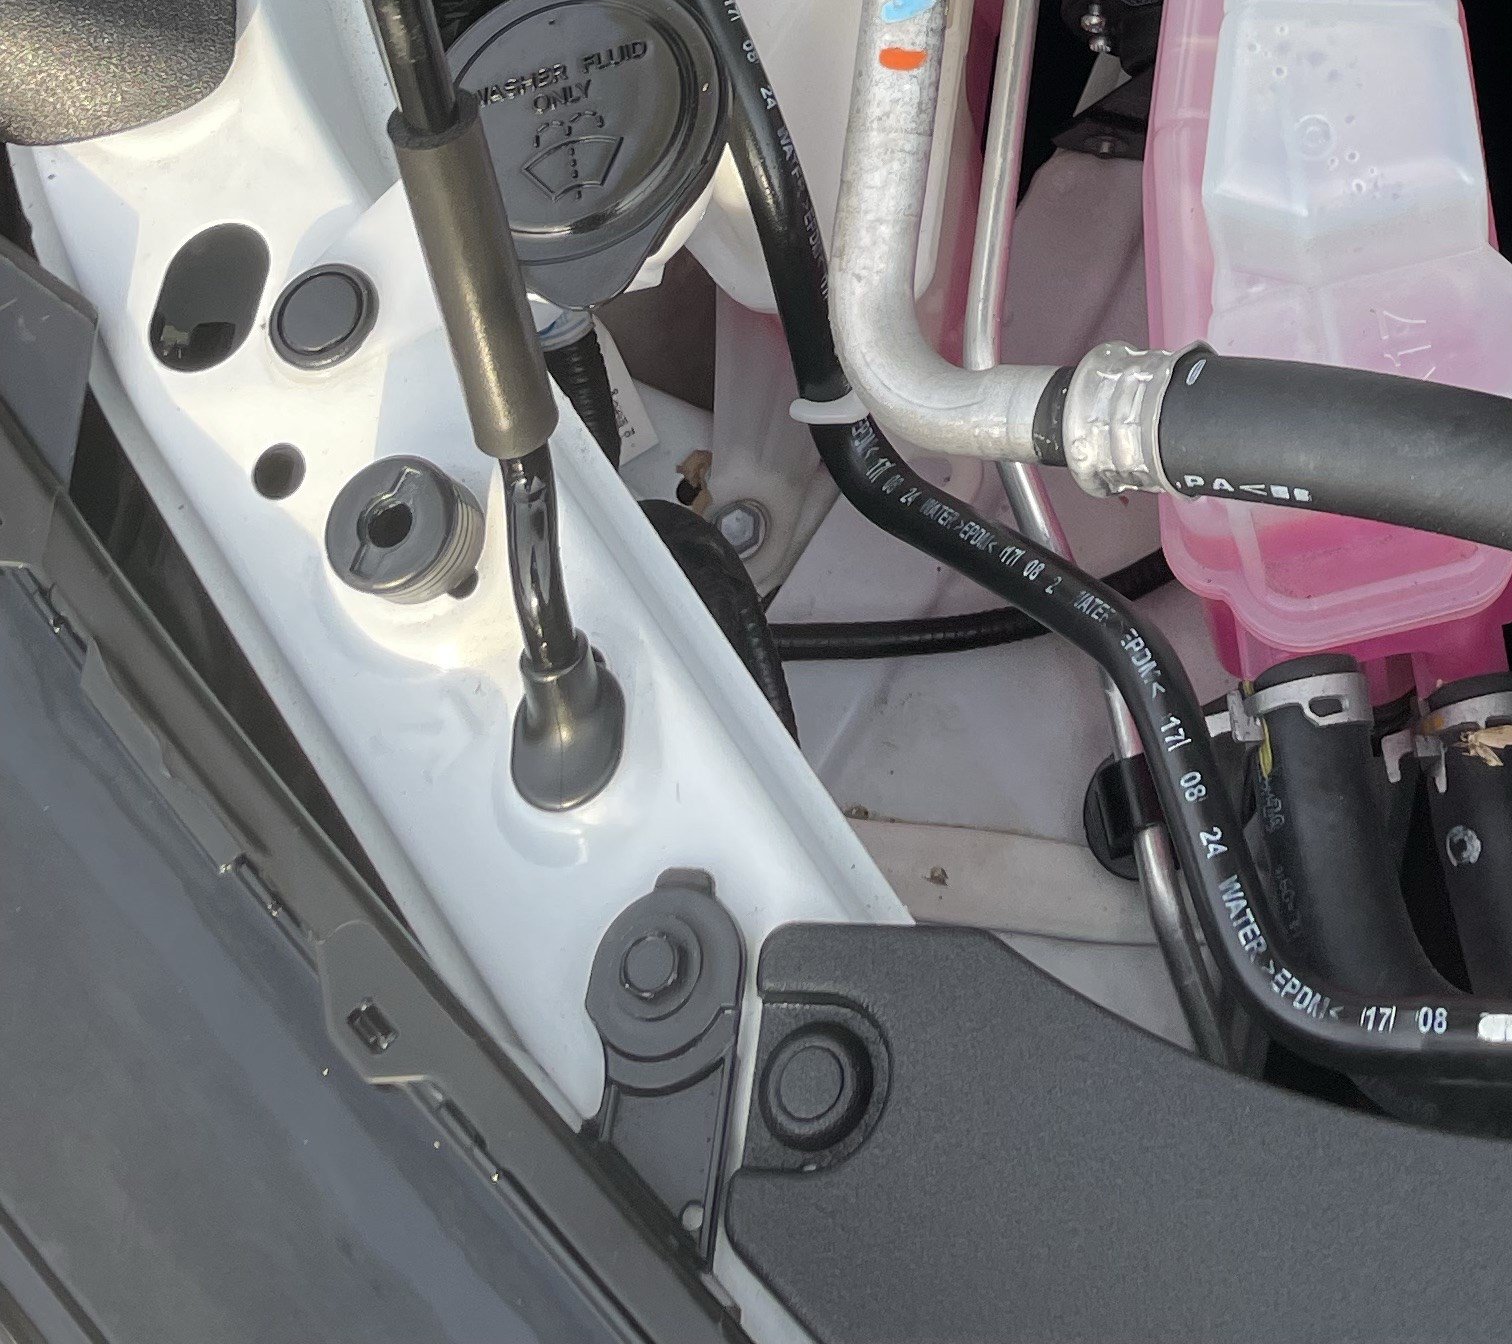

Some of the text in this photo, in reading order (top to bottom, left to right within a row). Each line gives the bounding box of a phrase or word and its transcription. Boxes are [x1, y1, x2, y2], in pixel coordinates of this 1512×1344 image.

[582, 41, 647, 74] FLUID
[742, 39, 758, 63] 08
[760, 85, 777, 110] 24
[534, 79, 592, 114] ONLY
[900, 487, 921, 506] 24
[920, 498, 960, 529] WATER
[1023, 559, 1045, 580] 08
[1179, 771, 1204, 802] 08
[1199, 827, 1227, 859] 24
[1217, 874, 1267, 964] WATER
[1415, 1006, 1448, 1034] 08
